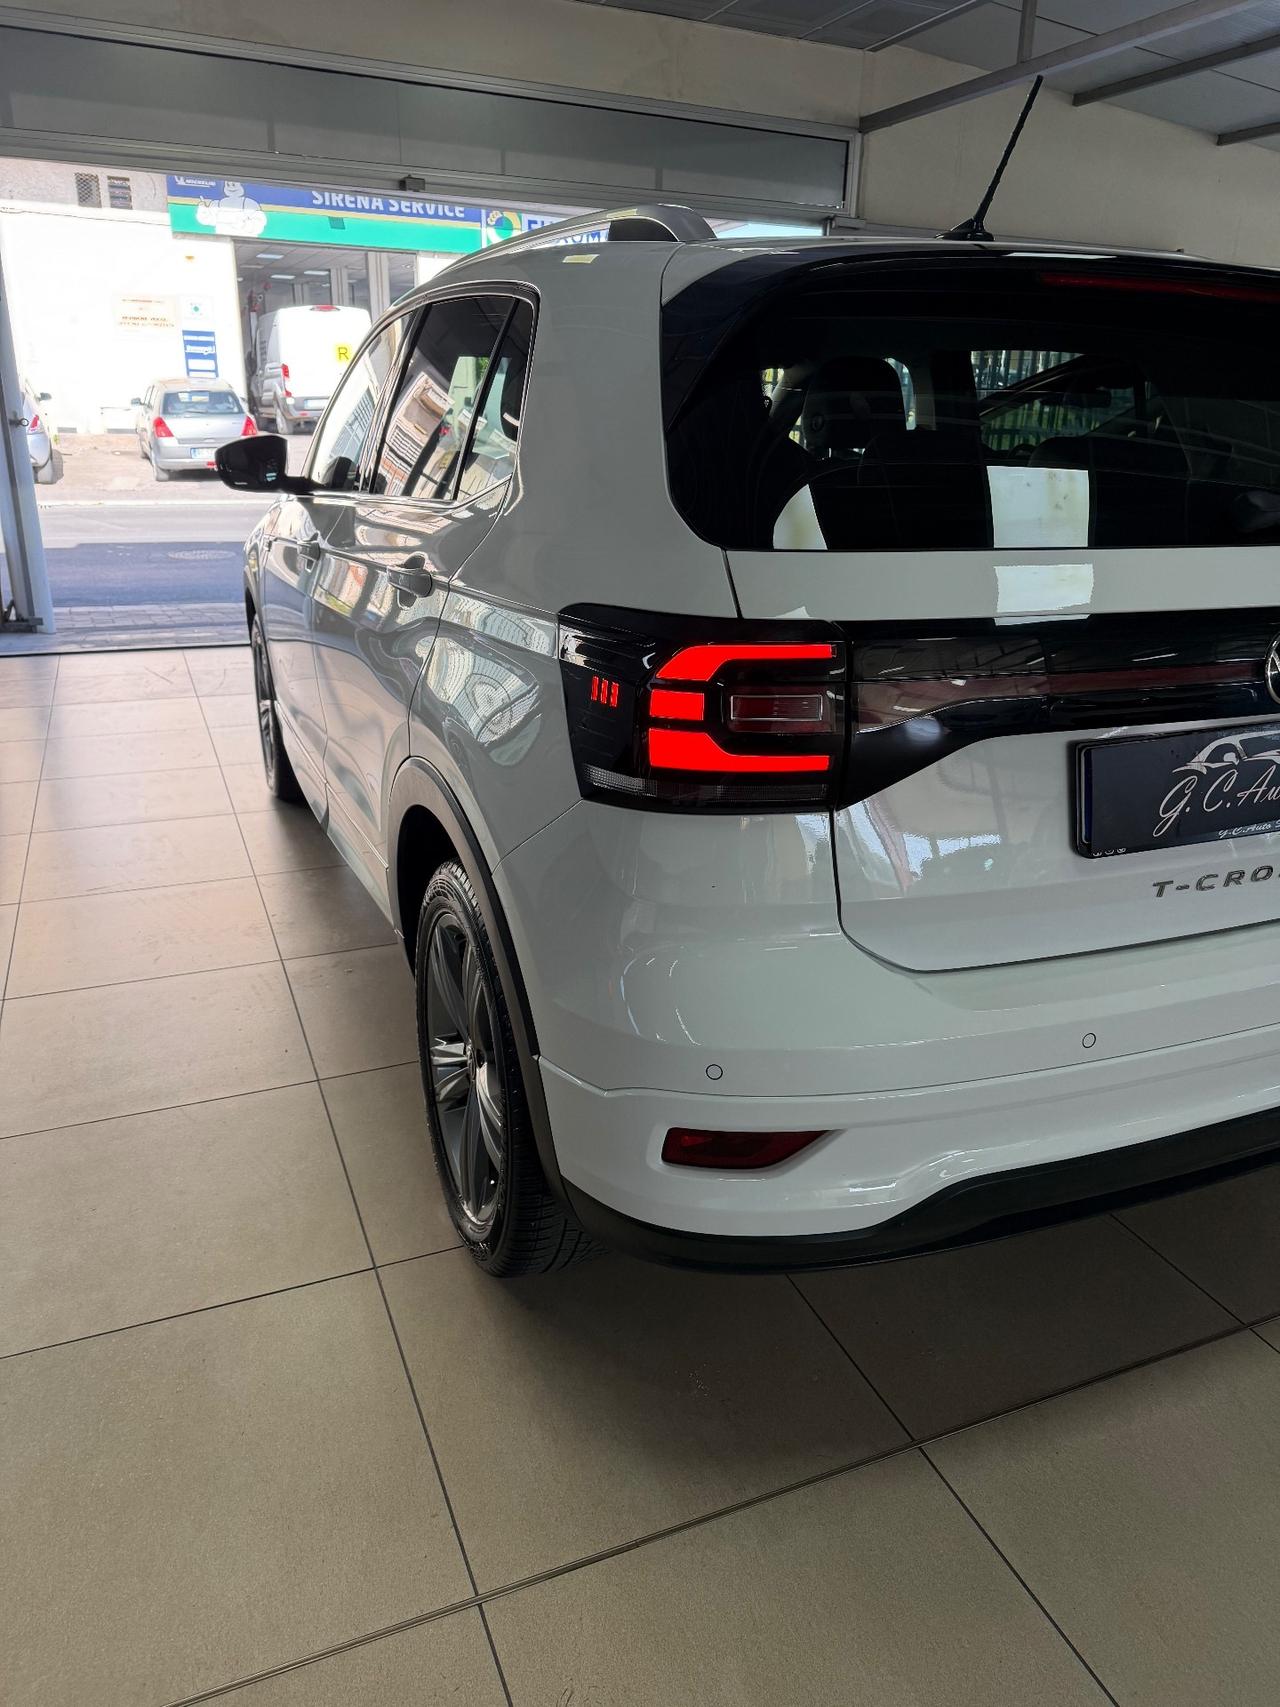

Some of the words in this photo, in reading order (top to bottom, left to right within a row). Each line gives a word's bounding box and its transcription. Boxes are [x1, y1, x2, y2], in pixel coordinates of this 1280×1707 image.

[311, 190, 384, 211] SIRENA
[388, 199, 465, 218] SERVICE
[338, 346, 349, 361] R
[1152, 865, 1280, 898] T-CRO
